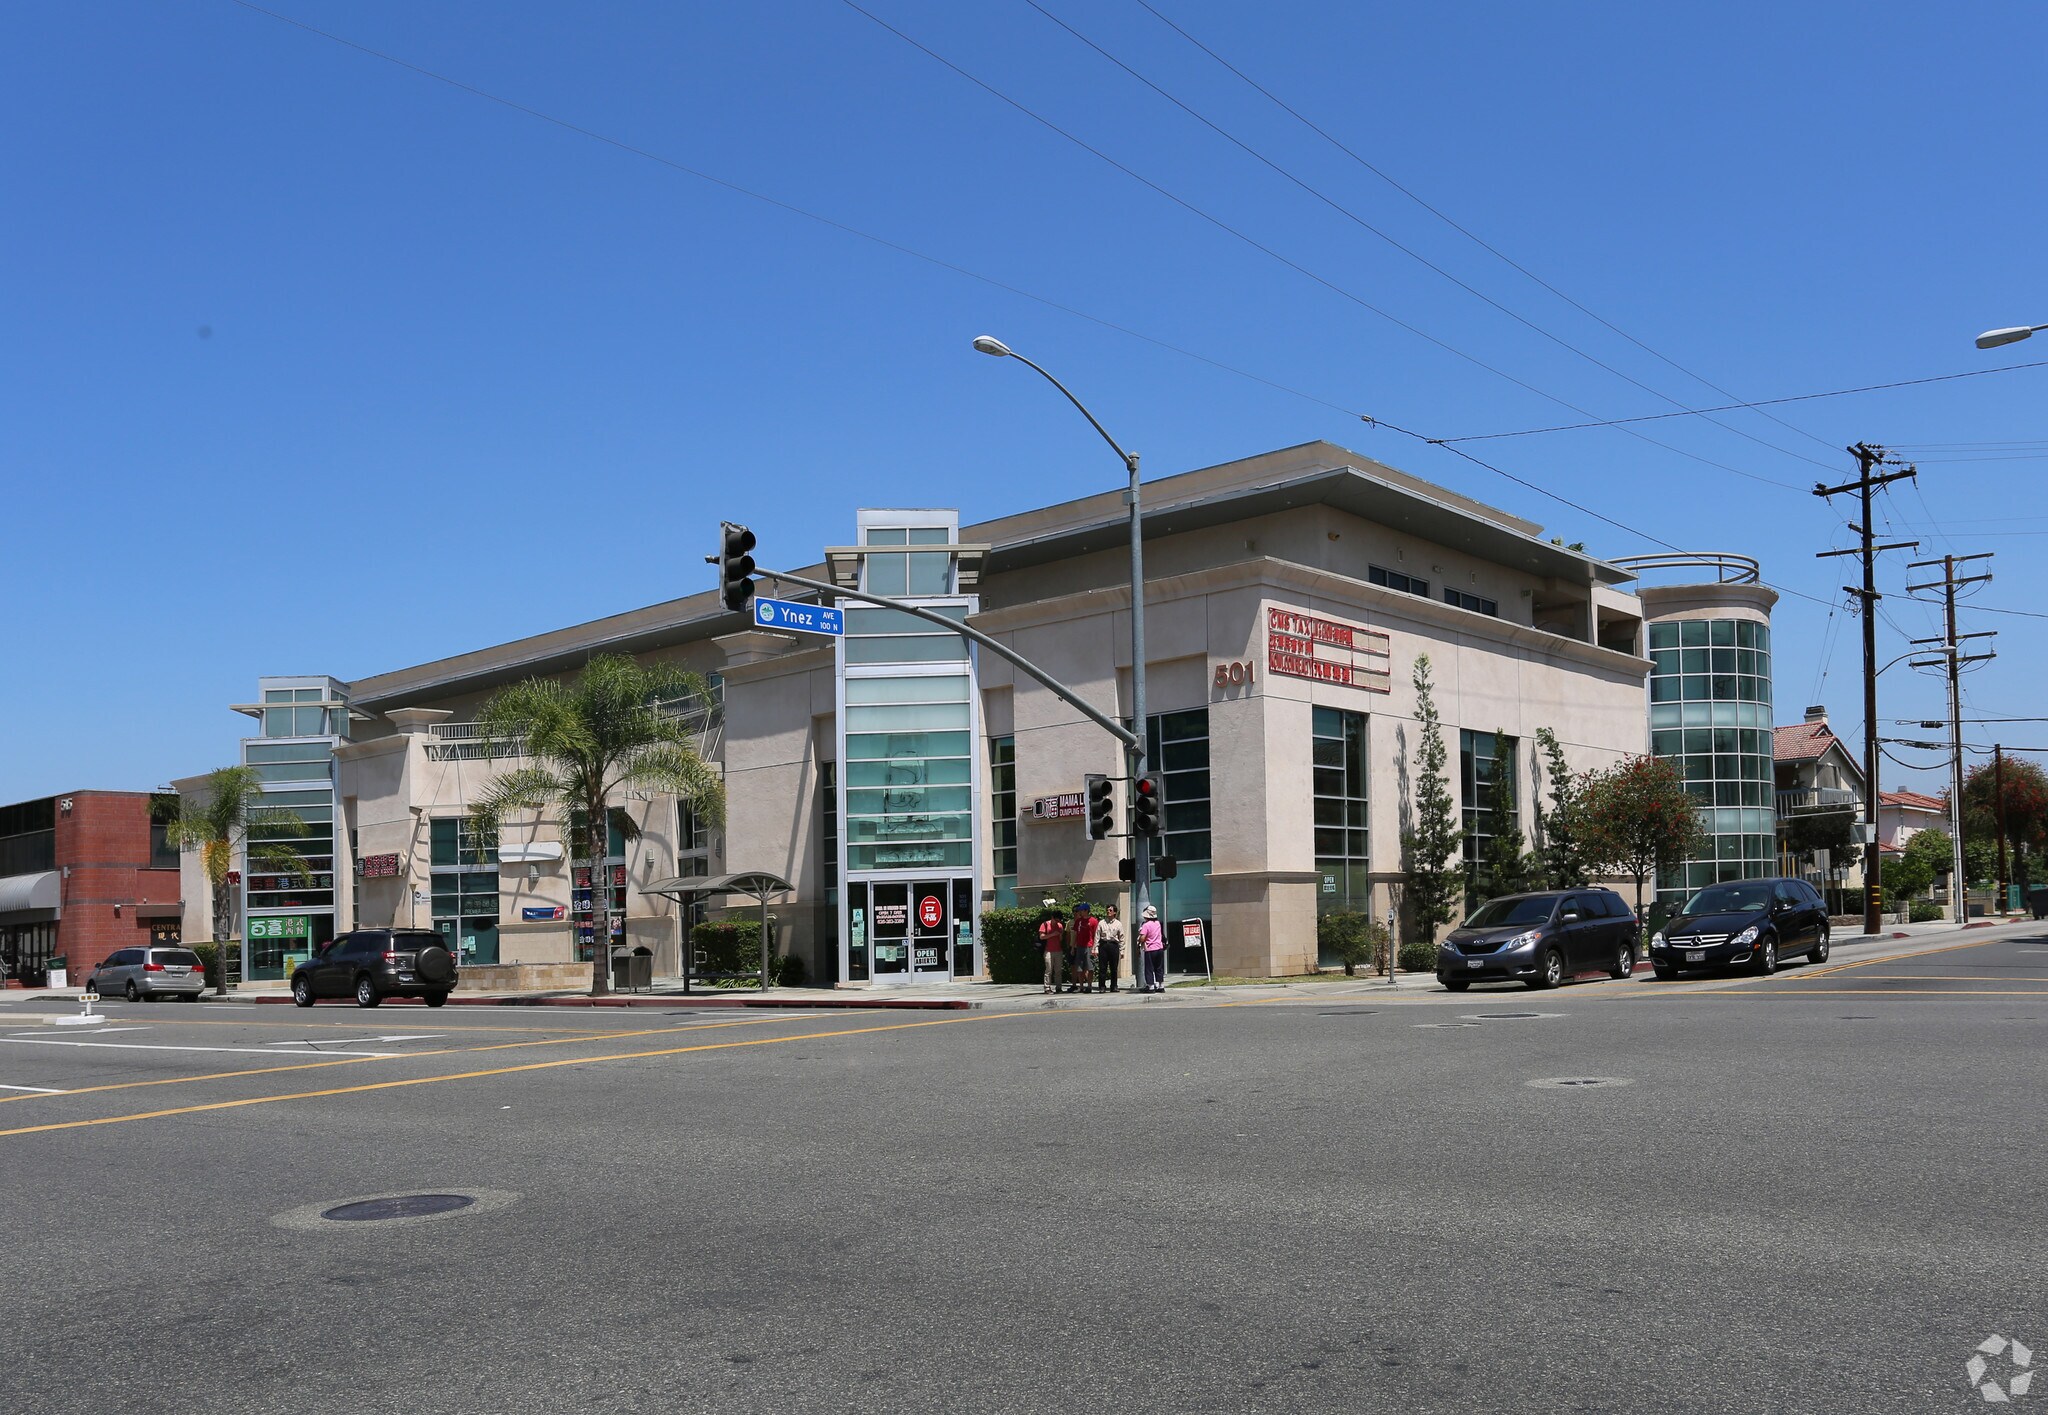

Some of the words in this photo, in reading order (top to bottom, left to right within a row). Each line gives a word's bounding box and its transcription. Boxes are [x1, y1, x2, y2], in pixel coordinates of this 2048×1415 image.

[781, 607, 812, 625] Ynez
[823, 612, 834, 620] AVE
[1270, 611, 1290, 631] CMS
[1293, 615, 1311, 636] TAX
[820, 622, 830, 630] 100
[1216, 660, 1254, 688] 501
[1060, 794, 1079, 807] MAMA
[1324, 876, 1334, 884] OPEN
[923, 901, 937, 921] 一口福
[251, 920, 282, 937] 百喜
